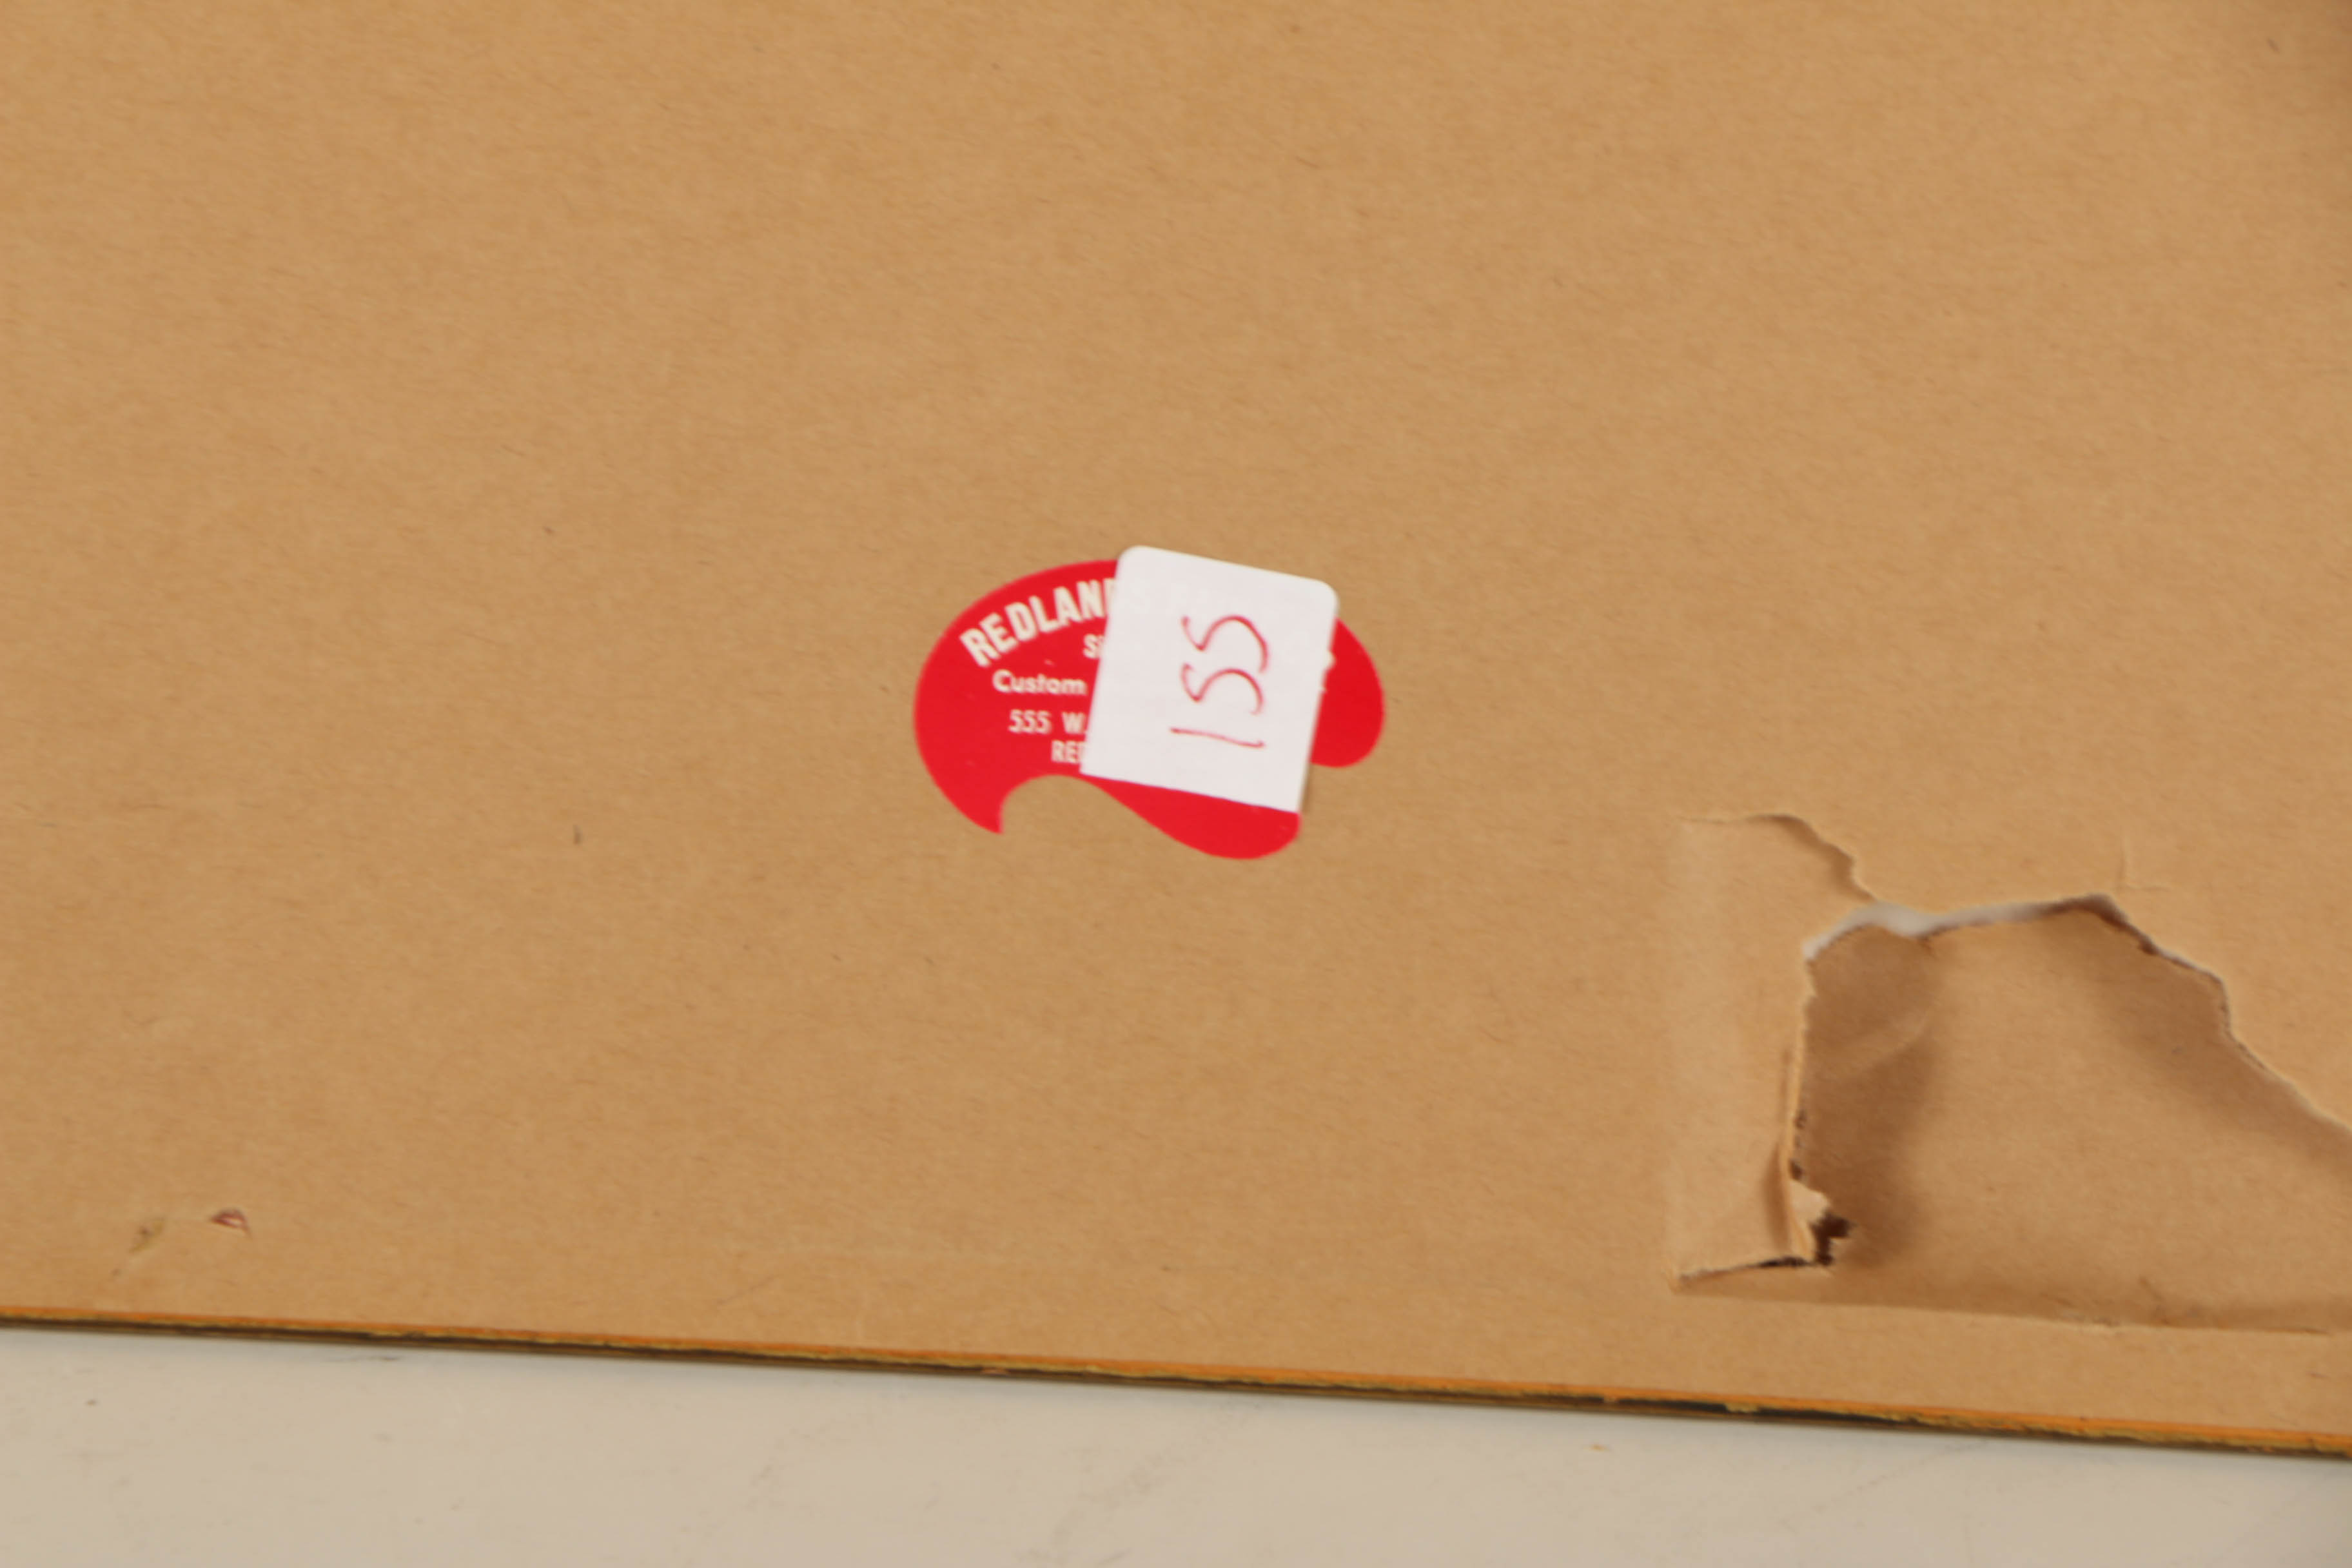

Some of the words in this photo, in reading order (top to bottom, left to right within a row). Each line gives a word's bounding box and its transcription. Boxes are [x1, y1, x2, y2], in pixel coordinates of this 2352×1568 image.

[992, 669, 1088, 696] Custom
[1170, 614, 1269, 749] 155
[1008, 709, 1053, 734] 555
